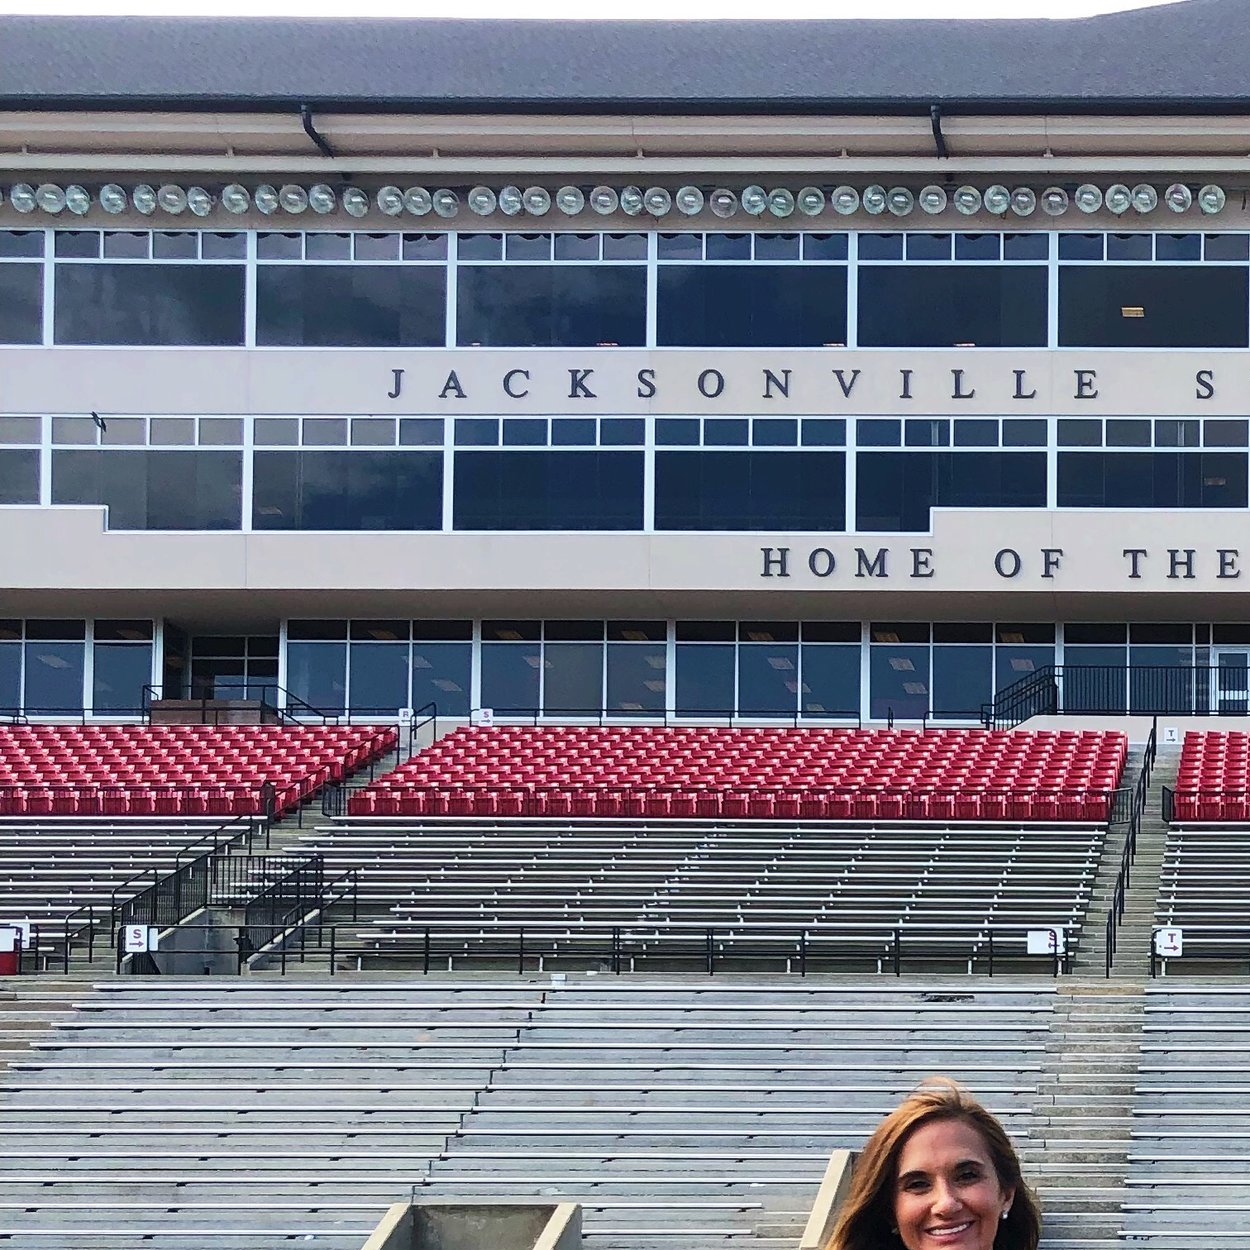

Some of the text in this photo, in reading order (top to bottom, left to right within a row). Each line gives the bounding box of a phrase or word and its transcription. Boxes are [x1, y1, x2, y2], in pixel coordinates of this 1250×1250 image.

[387, 369, 1099, 400] JACKSONVILLE
[760, 547, 935, 578] HOME
[994, 548, 1064, 579] OF
[1122, 549, 1241, 579] THE
[402, 710, 410, 719] R
[483, 710, 490, 719] S
[1168, 729, 1175, 737] T
[132, 928, 142, 940] S
[1167, 932, 1177, 944] T
